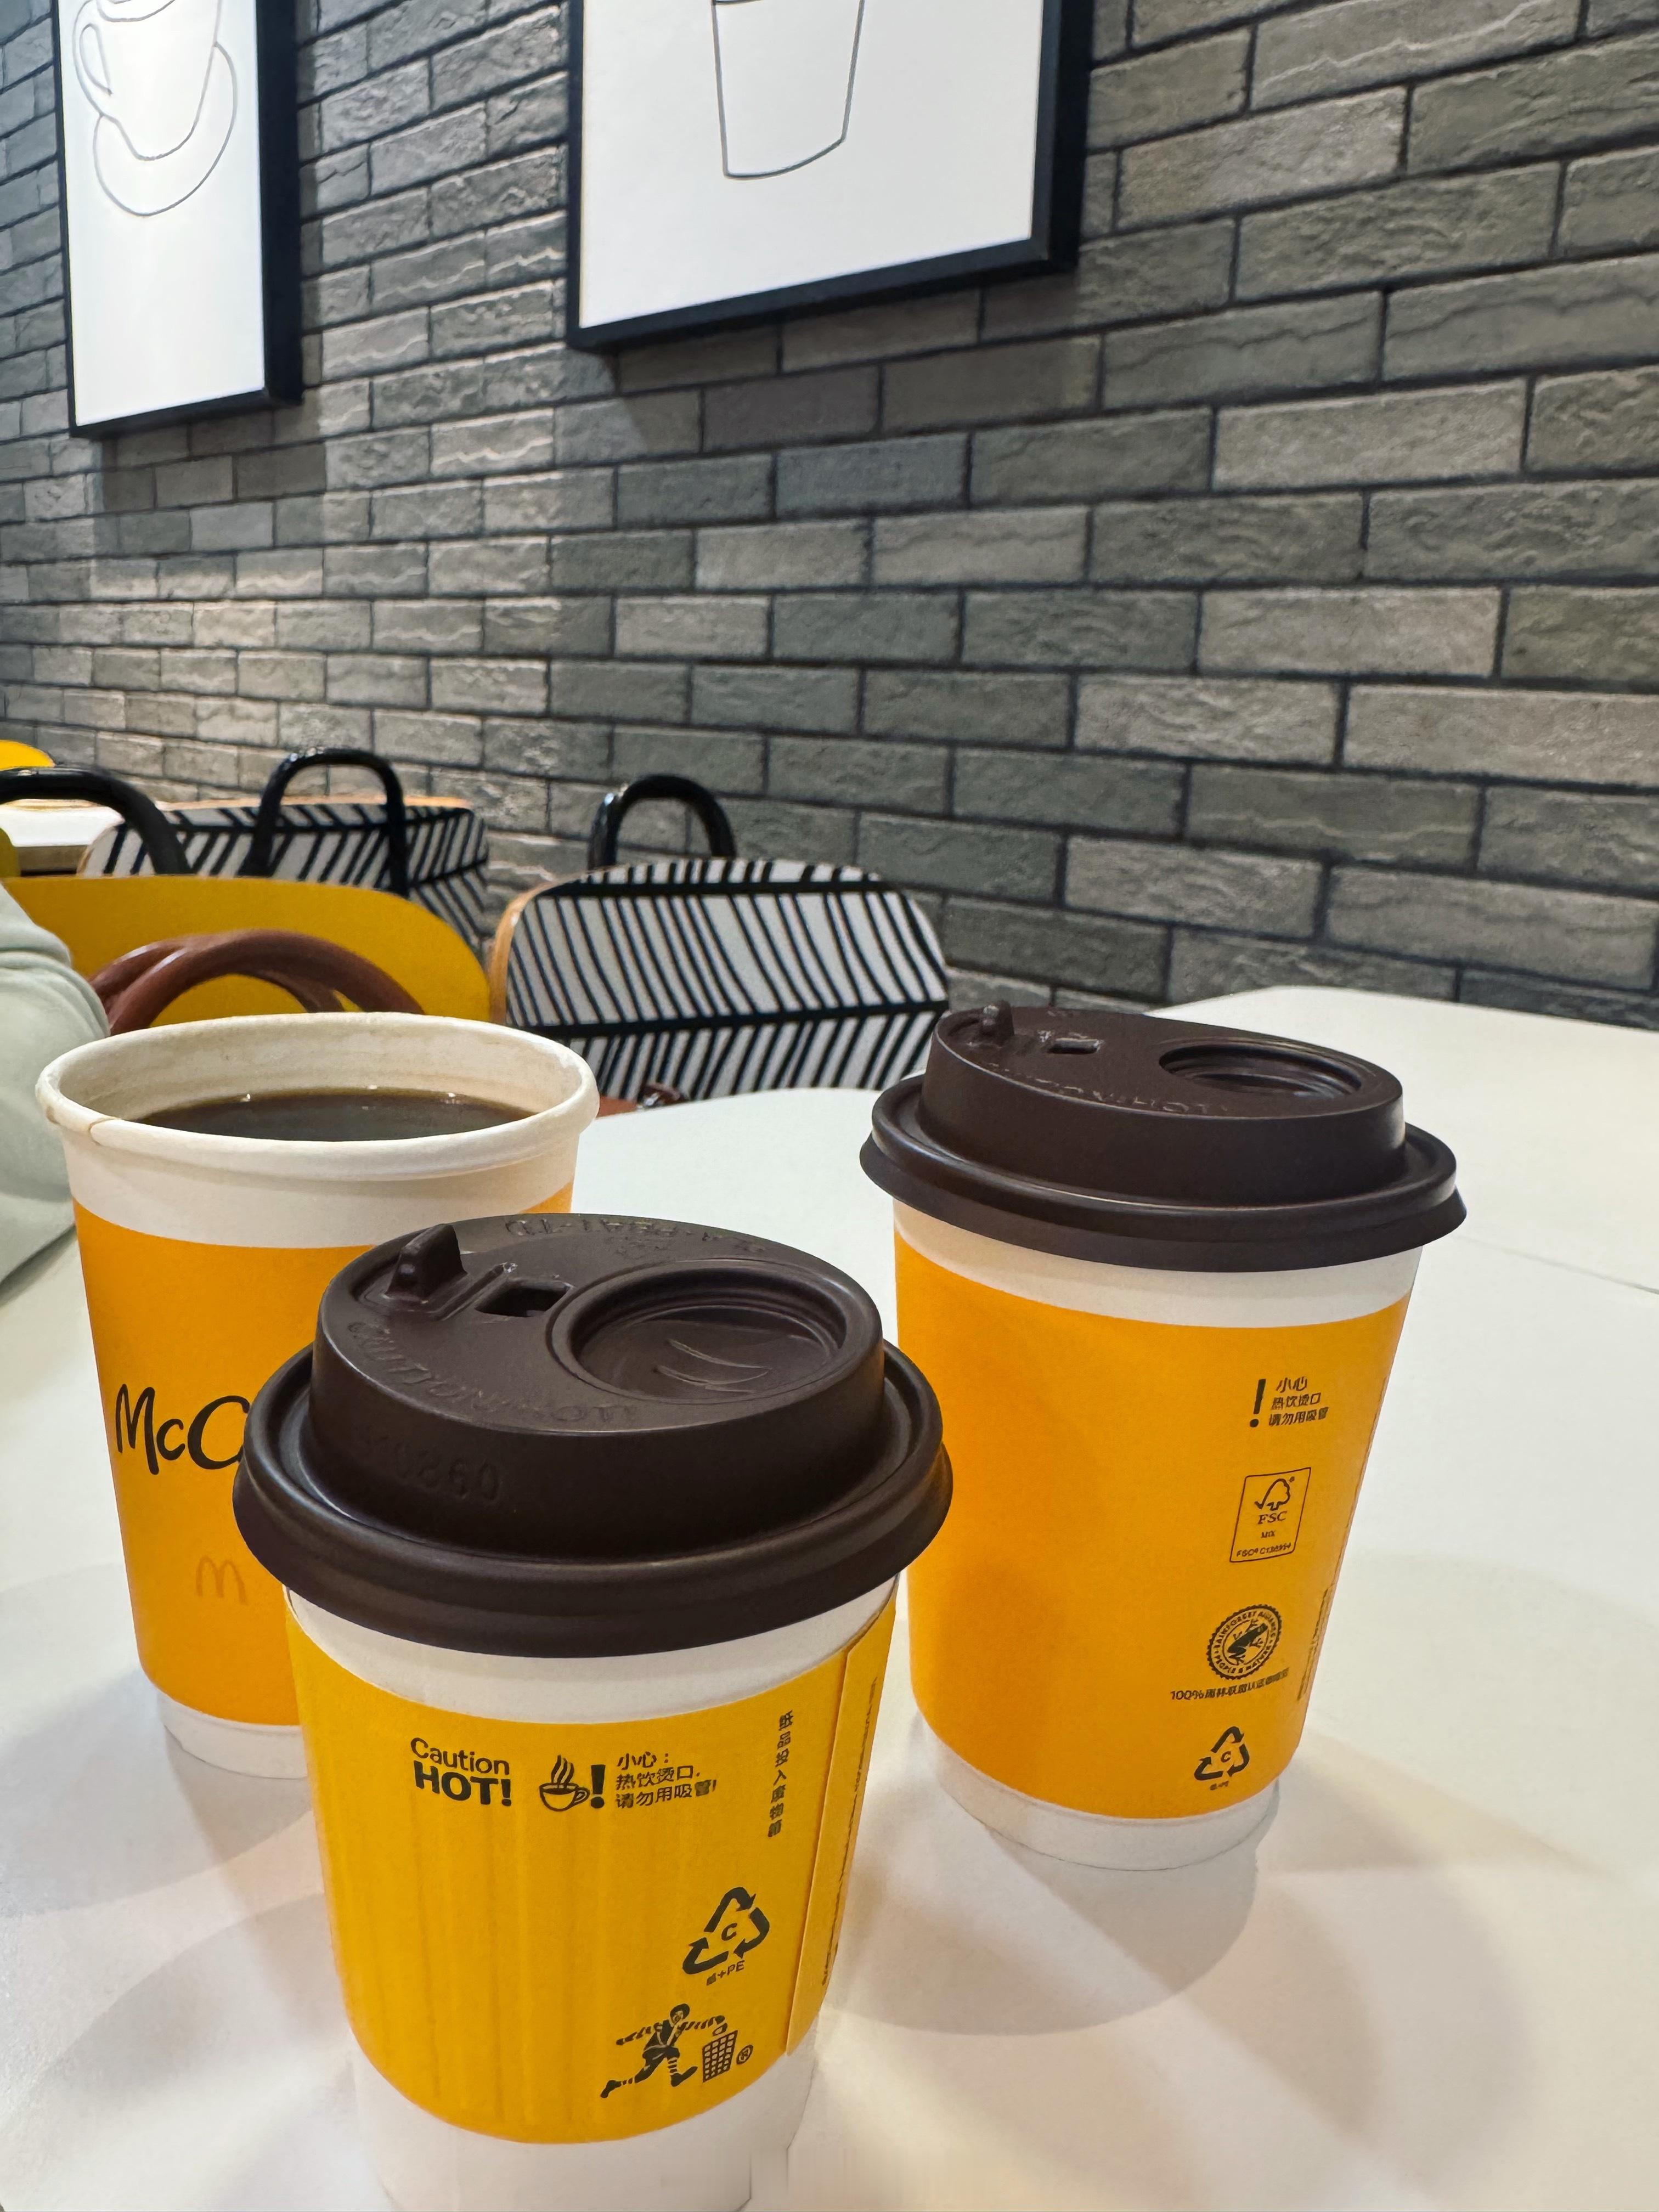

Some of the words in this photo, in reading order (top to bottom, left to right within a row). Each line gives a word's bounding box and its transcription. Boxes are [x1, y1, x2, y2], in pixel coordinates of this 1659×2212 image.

[1276, 1376, 1307, 1393] 小心
[115, 1384, 250, 1475] McC
[1257, 1511, 1287, 1524] FSC
[410, 1737, 510, 1775] Caution
[414, 1760, 511, 1807] HOT!
[706, 1960, 745, 1985] +PE
